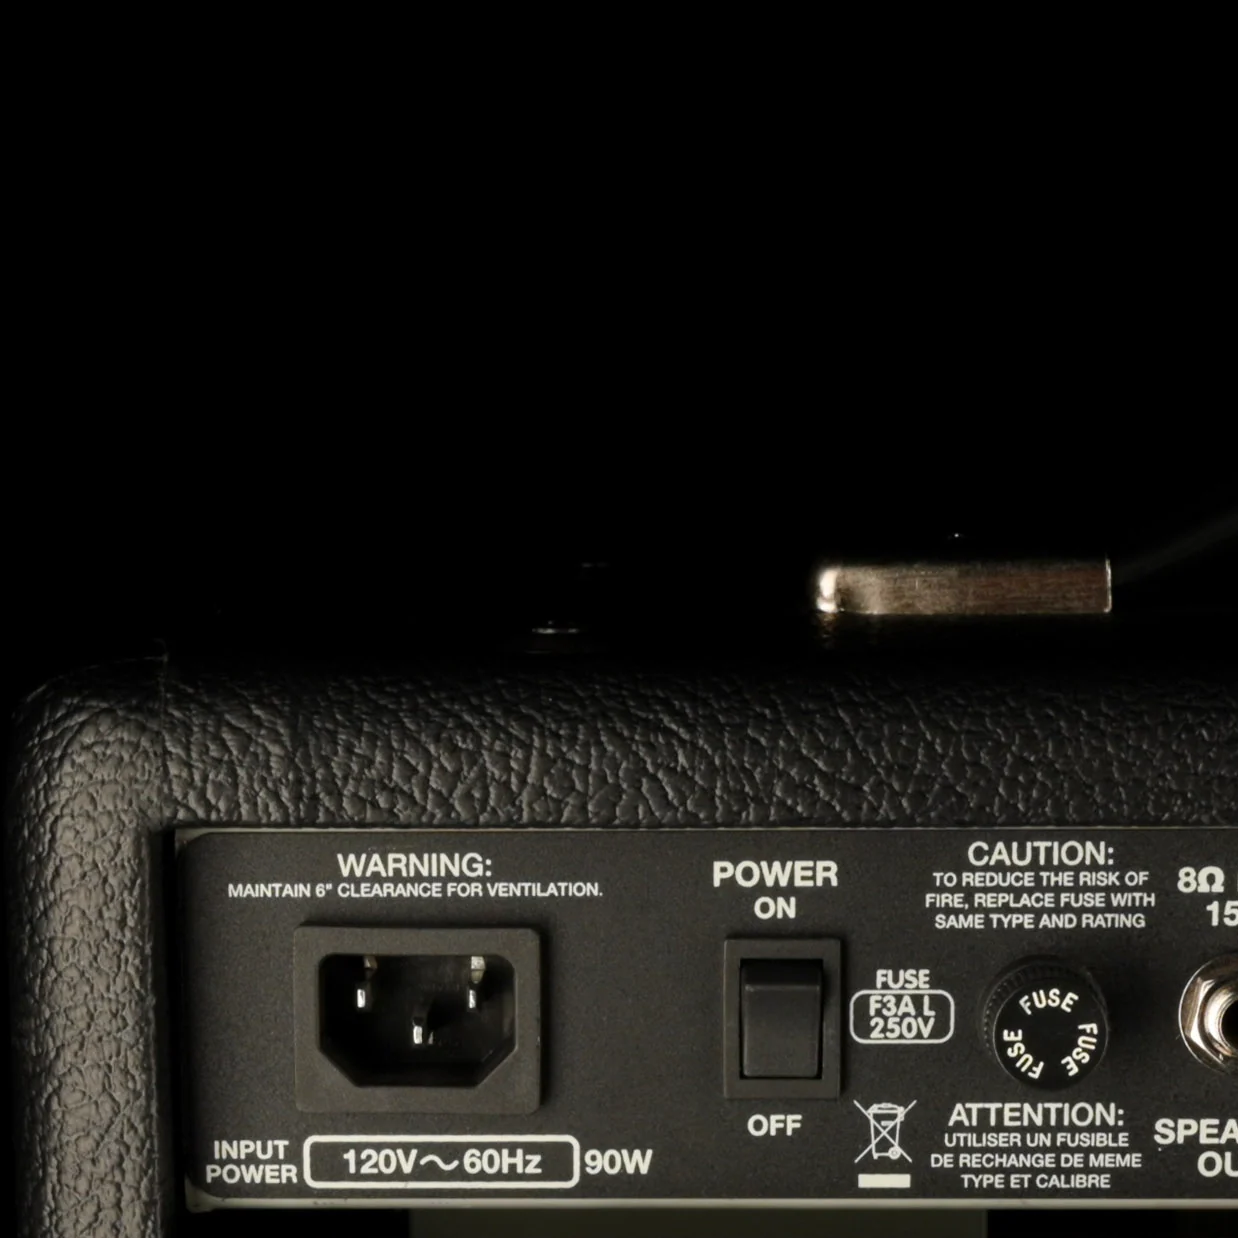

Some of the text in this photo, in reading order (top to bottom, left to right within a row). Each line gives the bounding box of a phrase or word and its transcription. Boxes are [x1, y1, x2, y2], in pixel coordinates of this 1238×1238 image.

[968, 841, 1113, 866] CAUTION:
[337, 853, 491, 877] WARNING:
[713, 861, 837, 887] POWER
[228, 883, 310, 897] MAINTAIN
[338, 883, 442, 897] CLEARANCE
[447, 883, 484, 897] FOR
[487, 882, 602, 897] VENTILATION.
[933, 871, 1149, 887] TO REDUCE THE RISK OF
[754, 897, 795, 919] ON
[926, 892, 1155, 909] FIRE, REPLACE FUSE WITH
[935, 913, 1145, 929] SAME TYPE AND RATING
[876, 970, 930, 989] FUSE
[869, 995, 935, 1016] F3A L
[1019, 988, 1078, 1015] FUSE
[870, 1017, 935, 1038] 250V
[1003, 1029, 1044, 1078] FUSE
[1061, 1023, 1098, 1076] FUSE
[948, 1102, 1123, 1126] ATTENTION:
[748, 1114, 802, 1136] OFF
[215, 1140, 289, 1159] INPUT
[945, 1133, 1129, 1147] UTILISER UN FUSIBLE
[585, 1149, 652, 1174] 90W
[931, 1153, 1141, 1168] DE RECHANGE DE MEME
[207, 1164, 297, 1184] POWER
[961, 1174, 1110, 1188] TYPE ET CALIBRE
